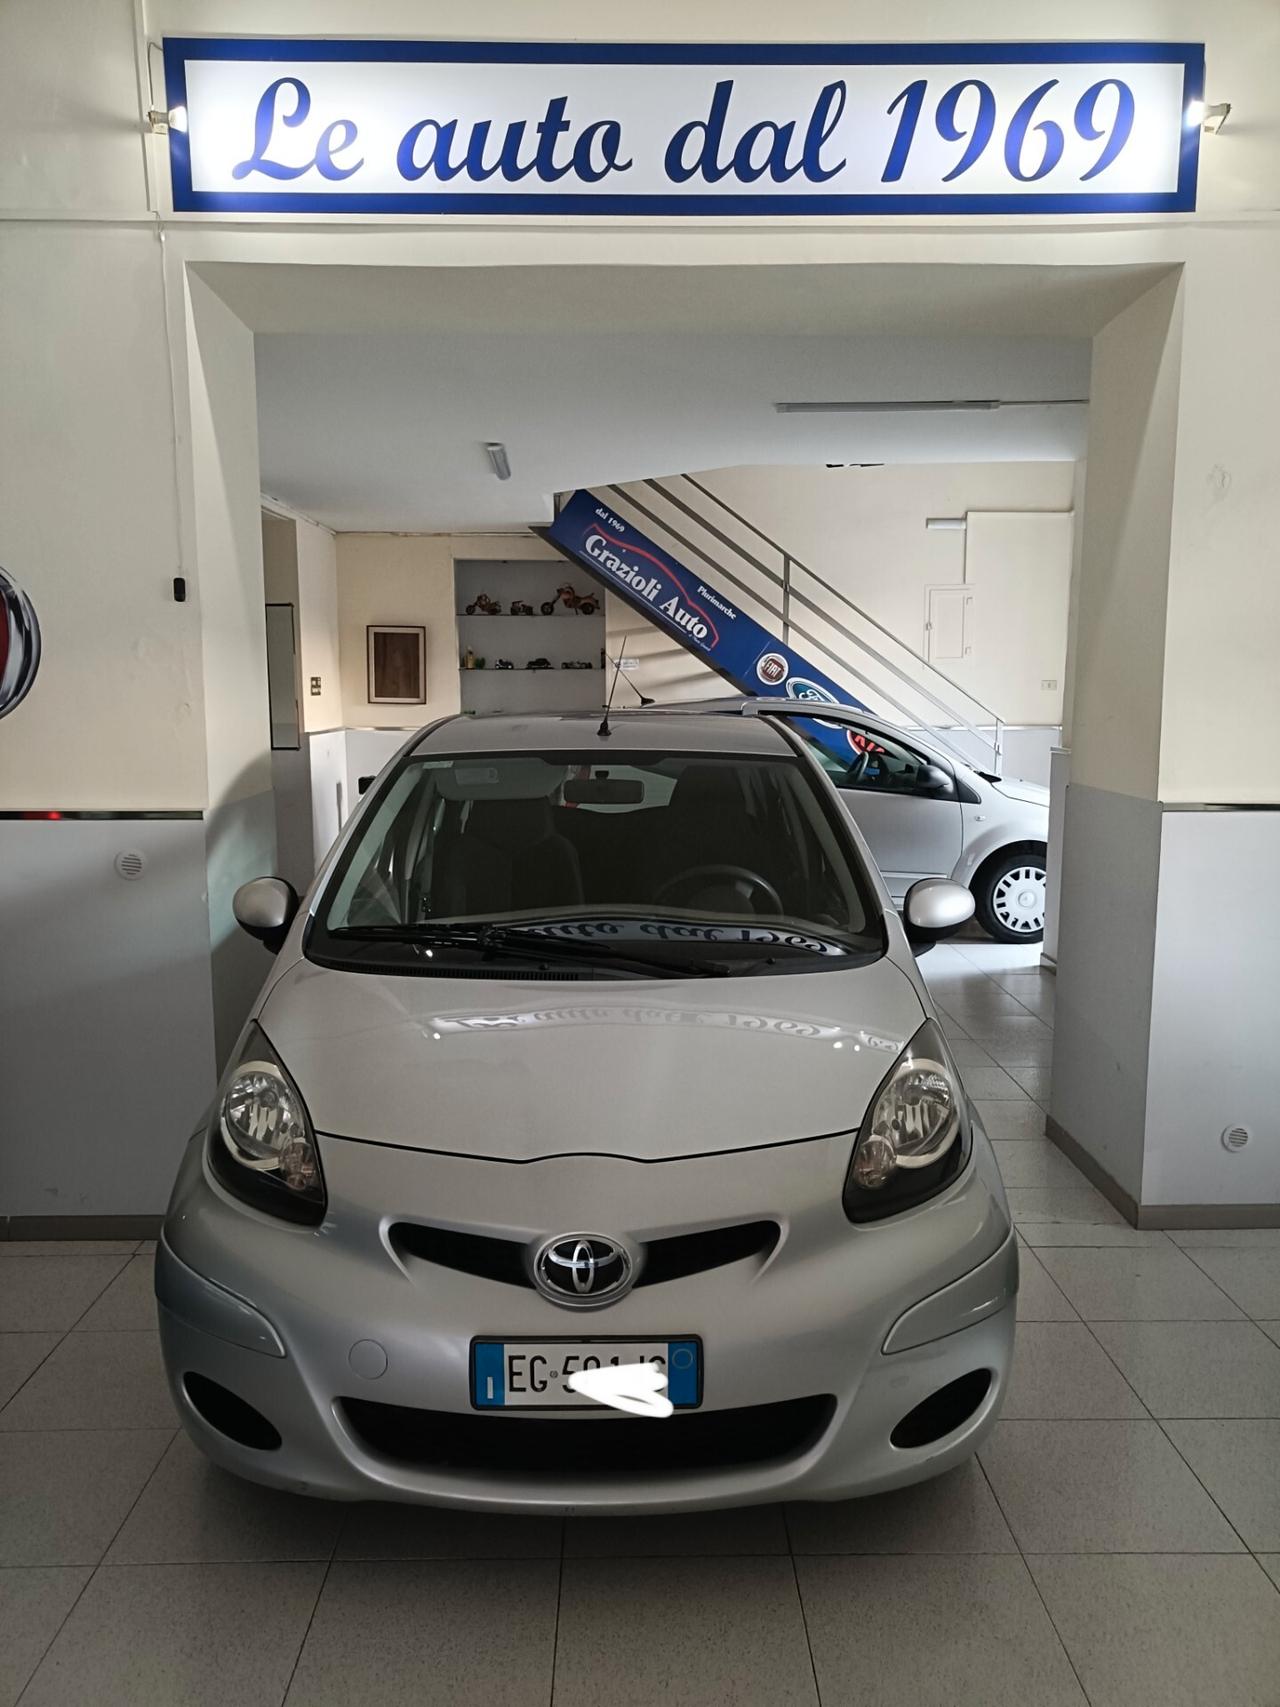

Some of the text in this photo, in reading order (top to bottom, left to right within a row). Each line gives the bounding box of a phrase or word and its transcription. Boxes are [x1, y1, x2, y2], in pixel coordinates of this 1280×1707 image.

[232, 77, 1135, 183] Le auto dal 1969
[595, 508, 625, 532] dal 1969
[585, 534, 708, 638] Grazioli Auto
[697, 585, 737, 620] Plurimarche
[765, 660, 783, 678] FIAT
